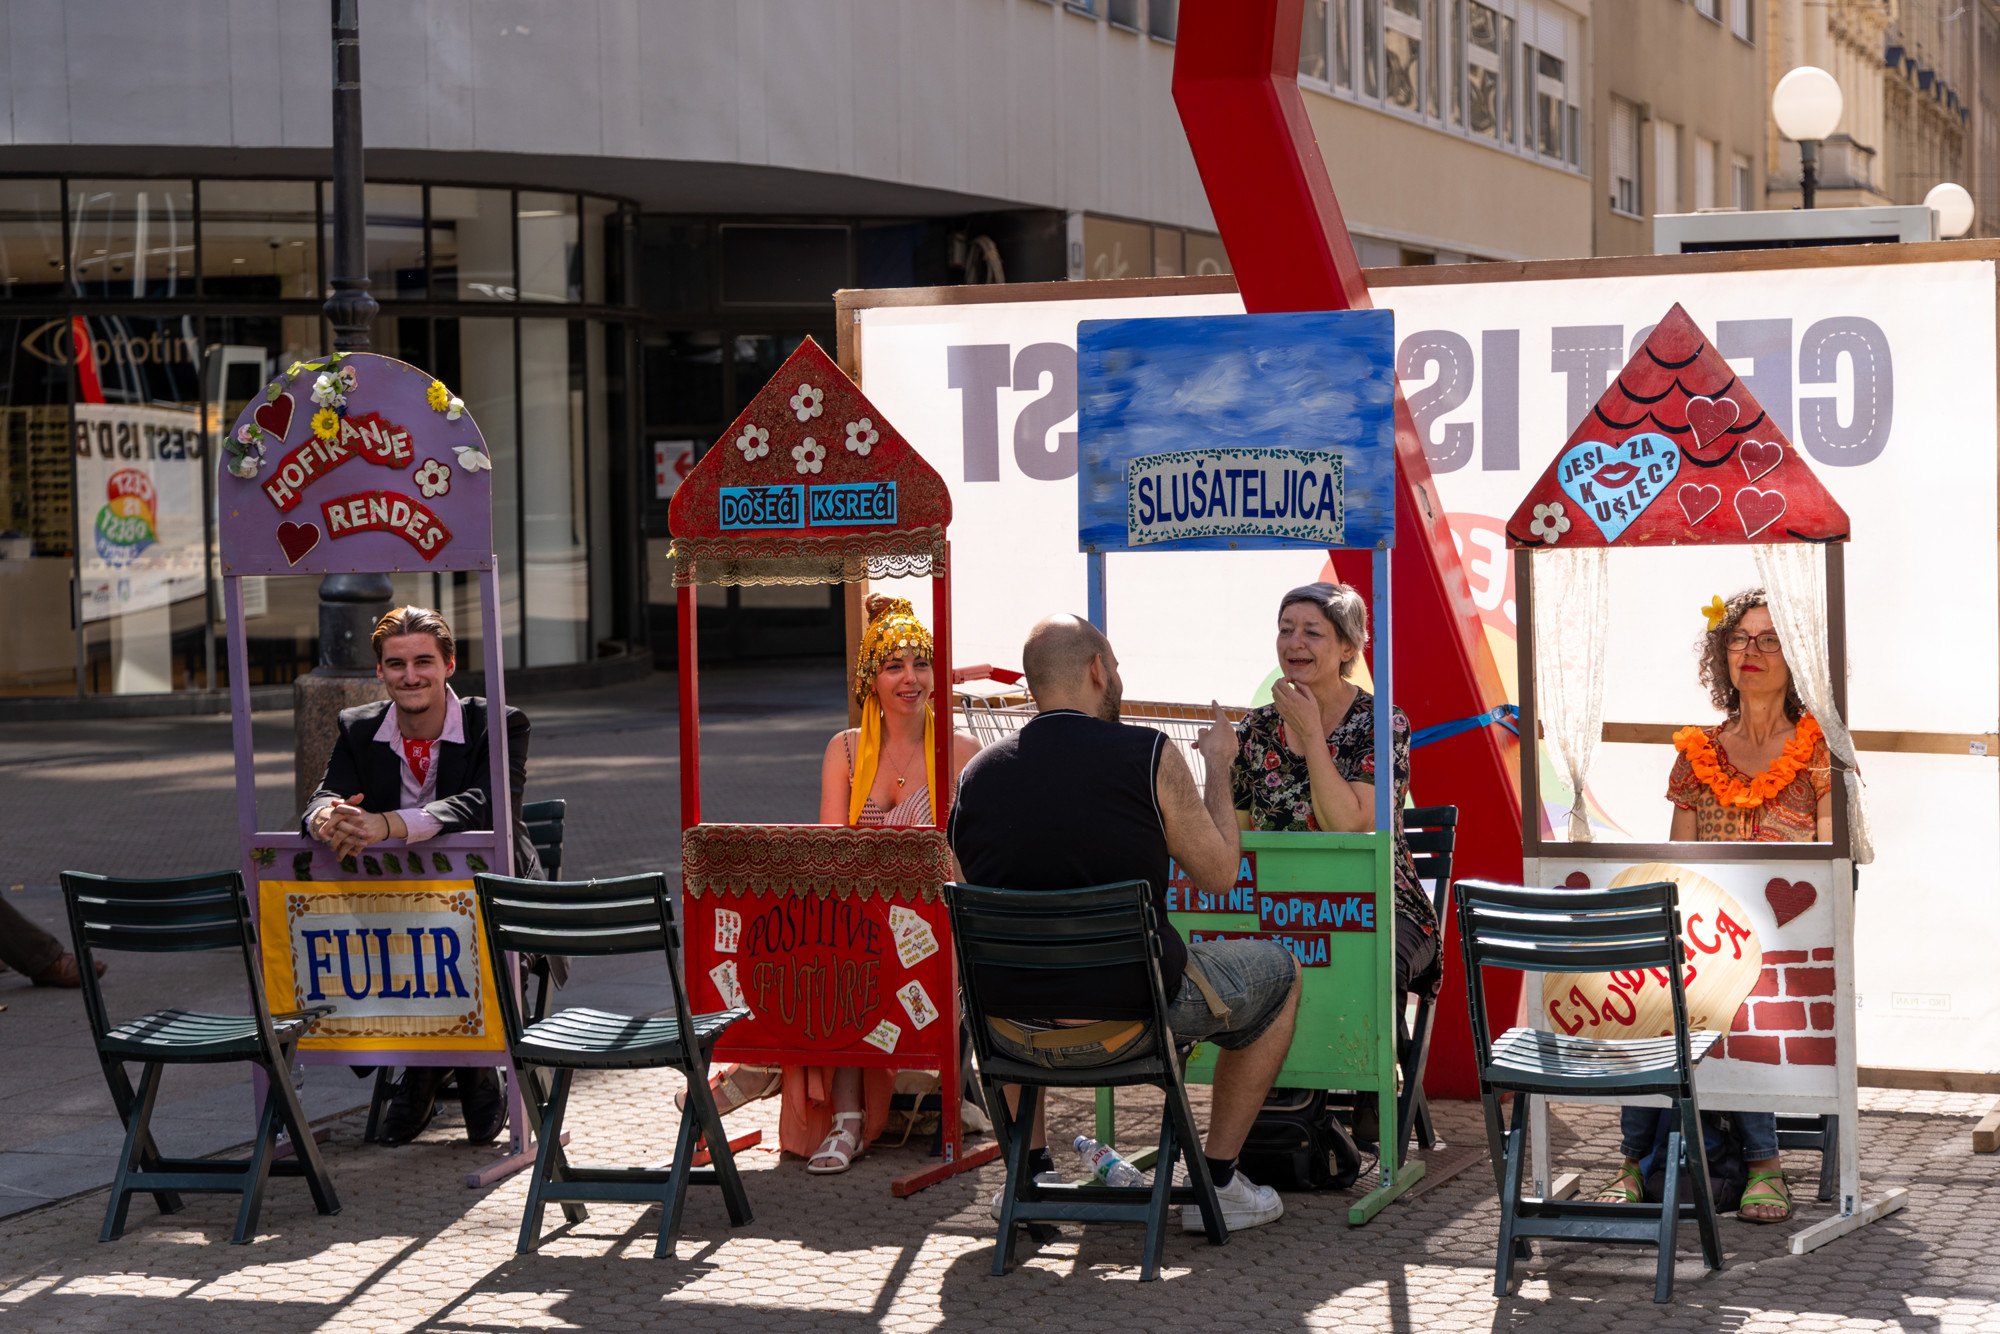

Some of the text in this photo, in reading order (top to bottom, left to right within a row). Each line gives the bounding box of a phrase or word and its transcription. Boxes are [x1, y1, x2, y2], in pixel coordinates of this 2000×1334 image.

[267, 419, 411, 508] HOFIRANJE
[1138, 460, 1336, 526] SLUŠATELJICA
[1564, 437, 1655, 484] JESI ZA
[328, 497, 443, 550] RENDES
[746, 890, 882, 958] POSITIVE
[1261, 897, 1374, 928] POPRAVKE
[301, 927, 470, 1001] FULIR
[753, 954, 881, 1040] FUTURE
